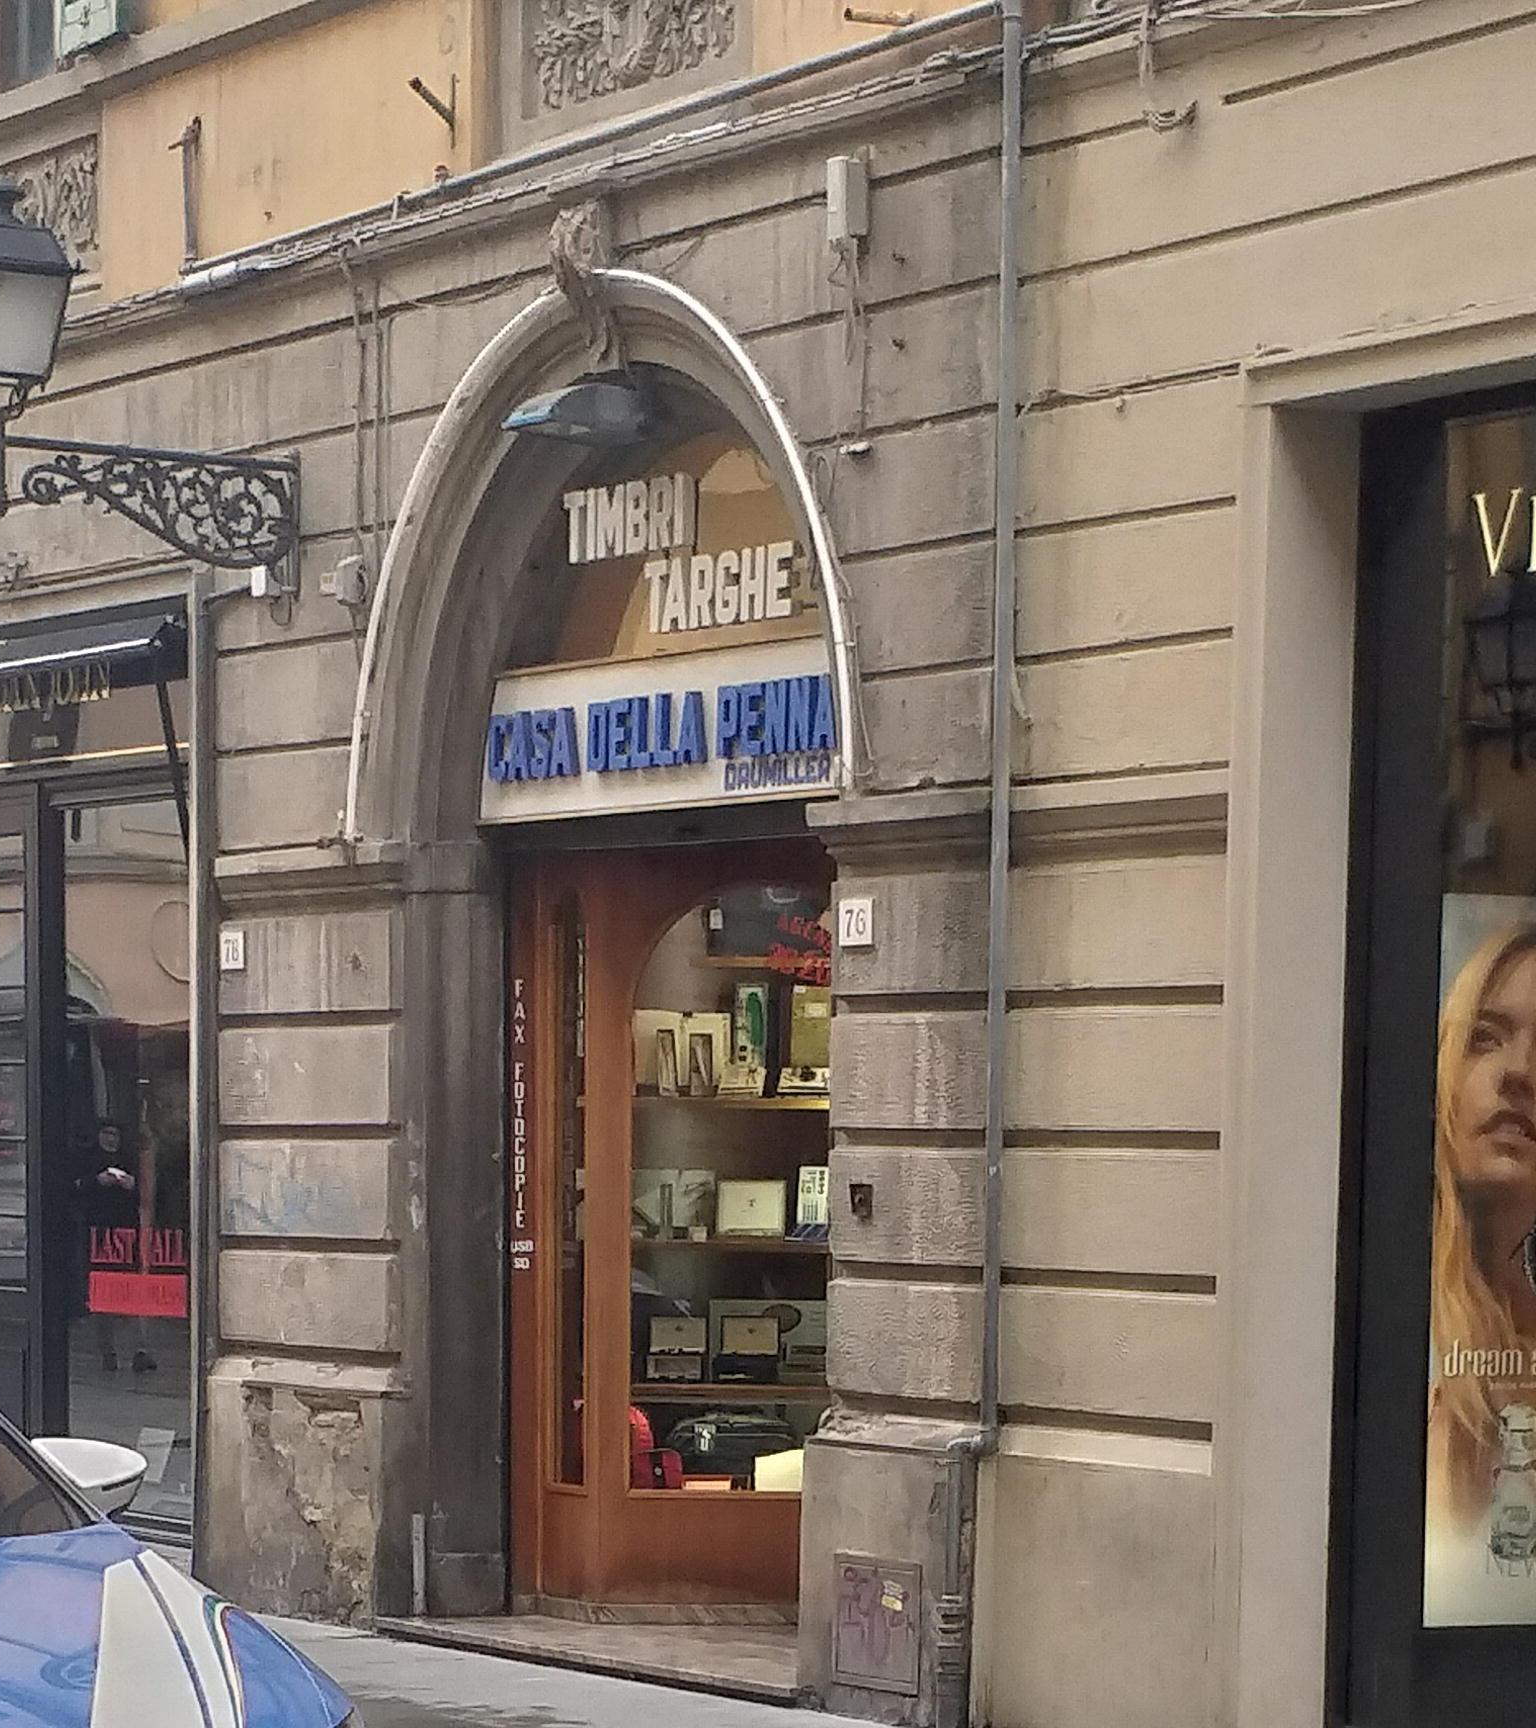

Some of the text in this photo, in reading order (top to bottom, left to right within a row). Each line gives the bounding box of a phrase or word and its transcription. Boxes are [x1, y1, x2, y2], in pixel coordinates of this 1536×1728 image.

[563, 472, 692, 565] TIMBRI
[644, 540, 794, 634] TARGHE
[488, 672, 841, 782] CASA DELLA PENNA
[724, 753, 831, 792] DAUMILLER
[845, 908, 866, 938] 76
[514, 979, 526, 1229] FAX FOTOCOPIE
[90, 1226, 135, 1264] LAST
[1444, 1339, 1523, 1377] dream
